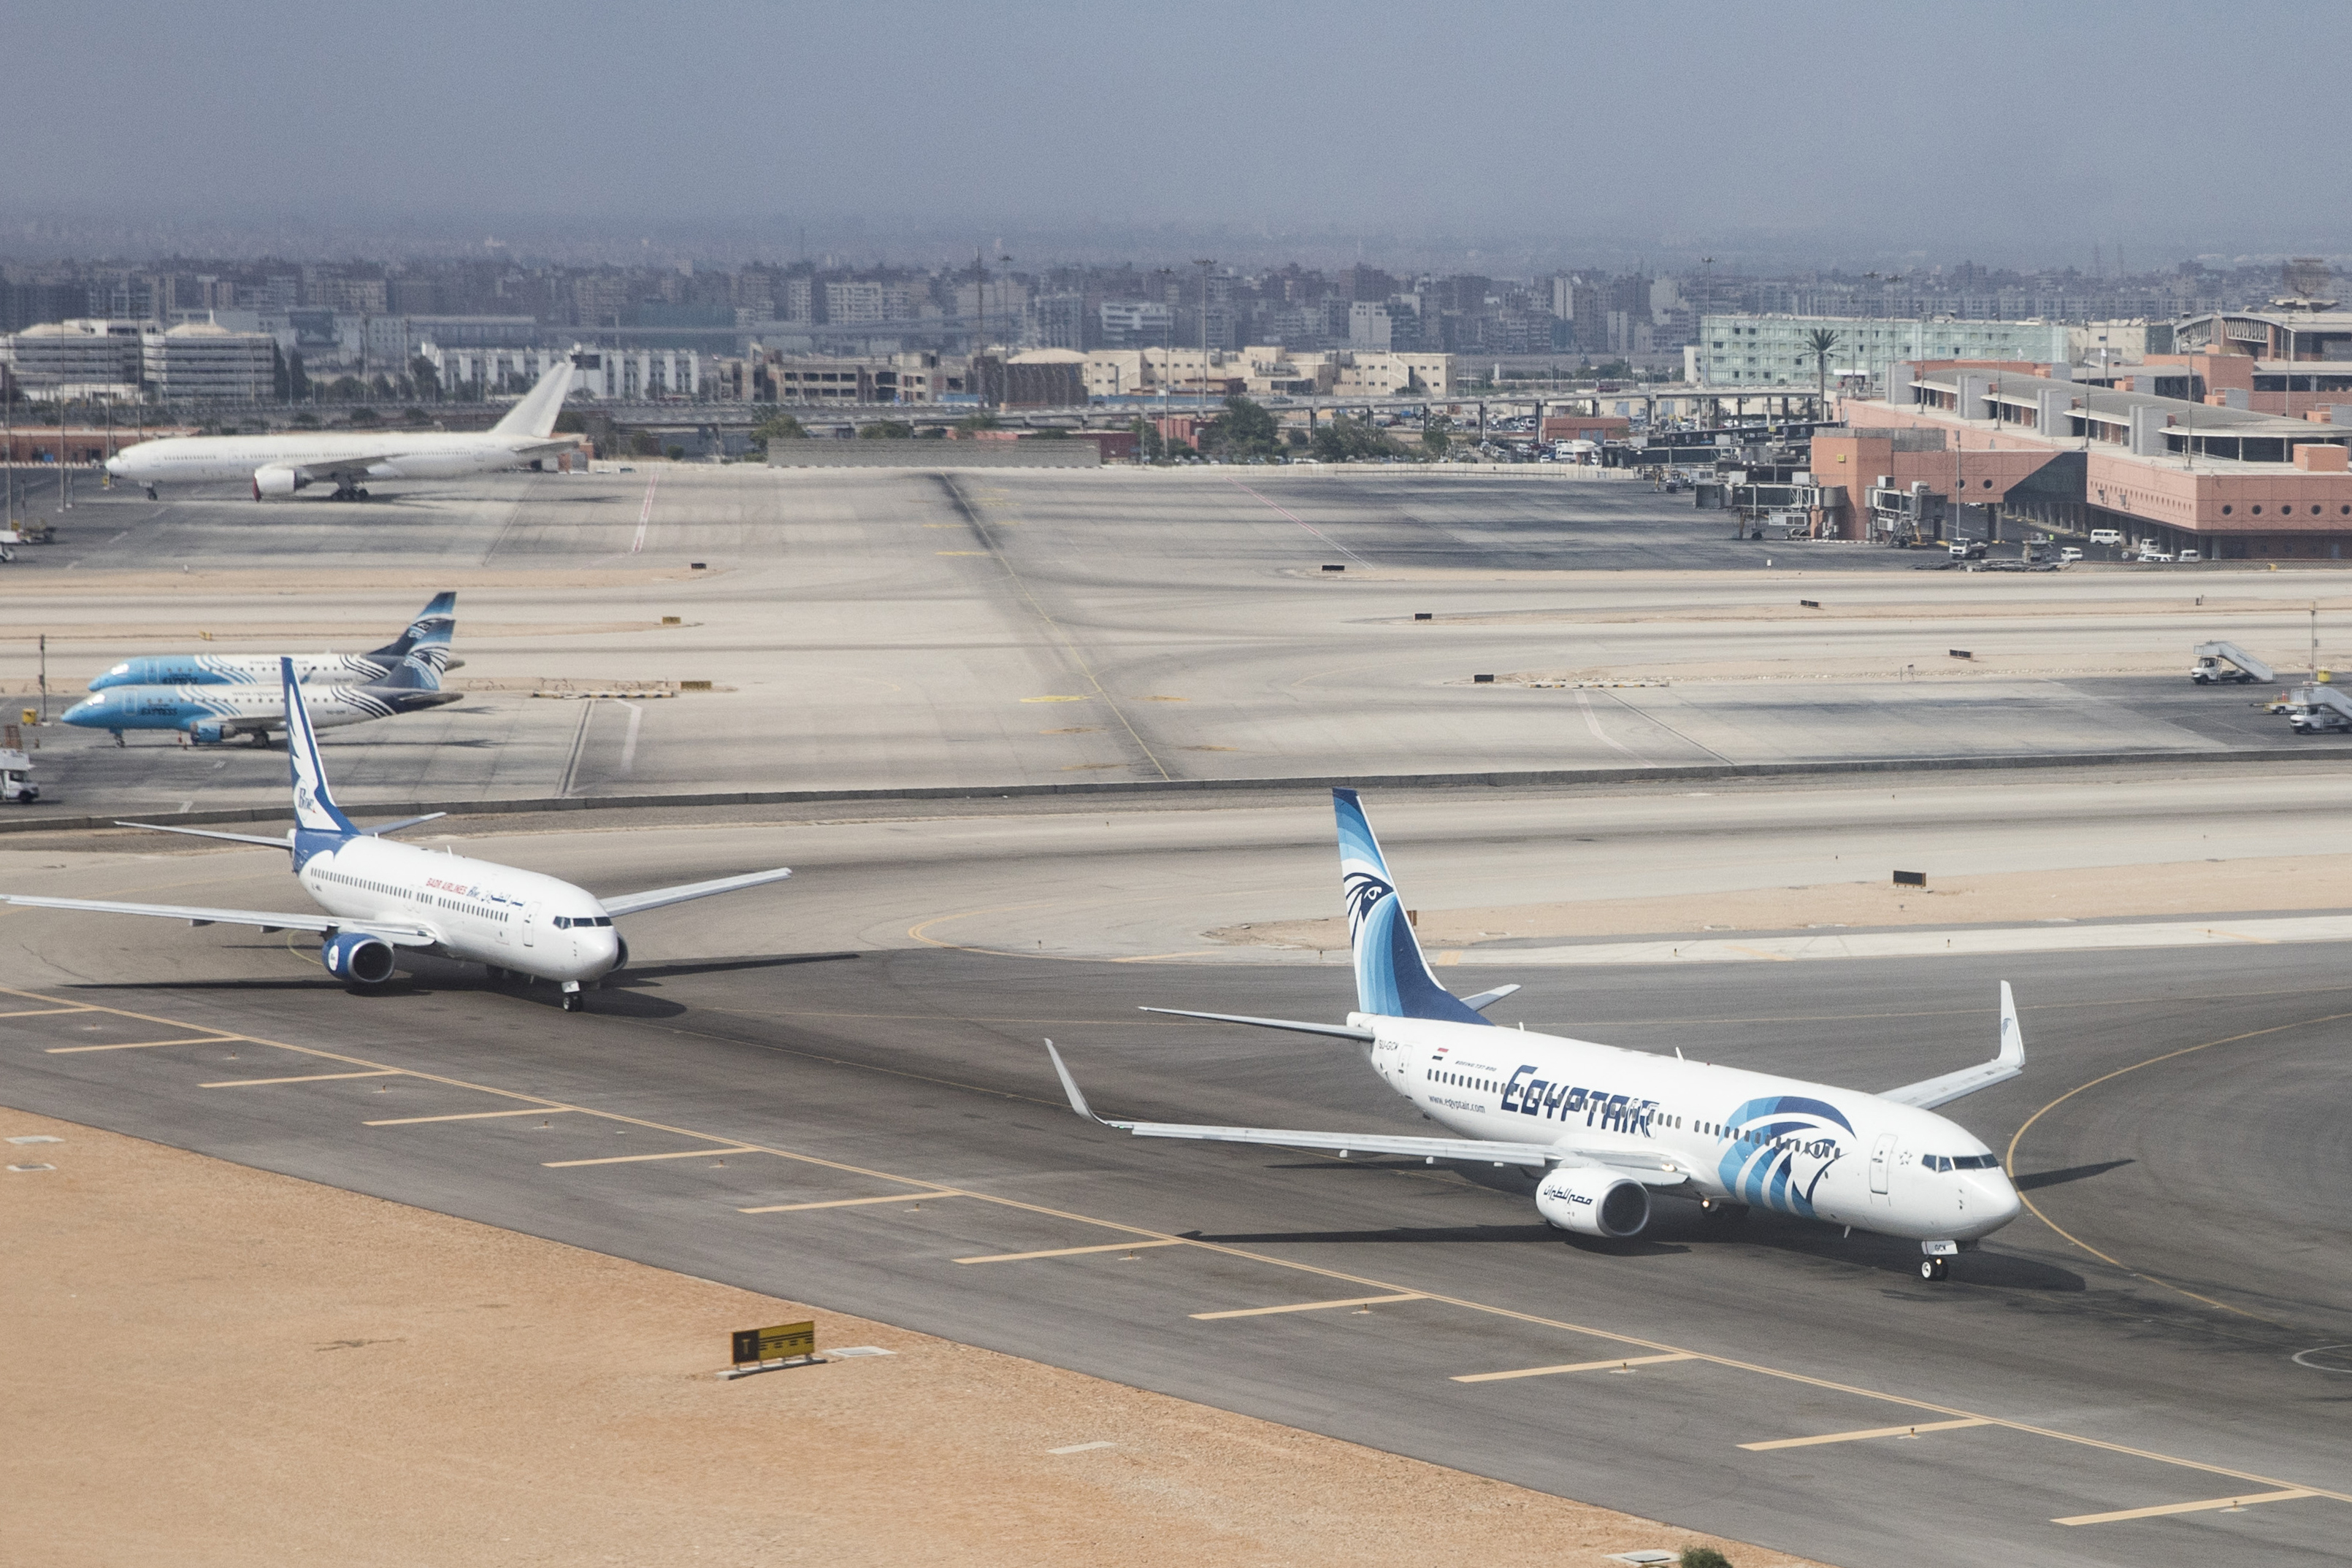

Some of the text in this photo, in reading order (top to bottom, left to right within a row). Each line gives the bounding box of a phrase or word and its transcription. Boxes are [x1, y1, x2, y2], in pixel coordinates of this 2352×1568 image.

[426, 877, 468, 895] BADR AIRLINES
[1428, 1095, 1486, 1114] www.egyptair.com
[1501, 1064, 1660, 1138] EGYPTAIR
